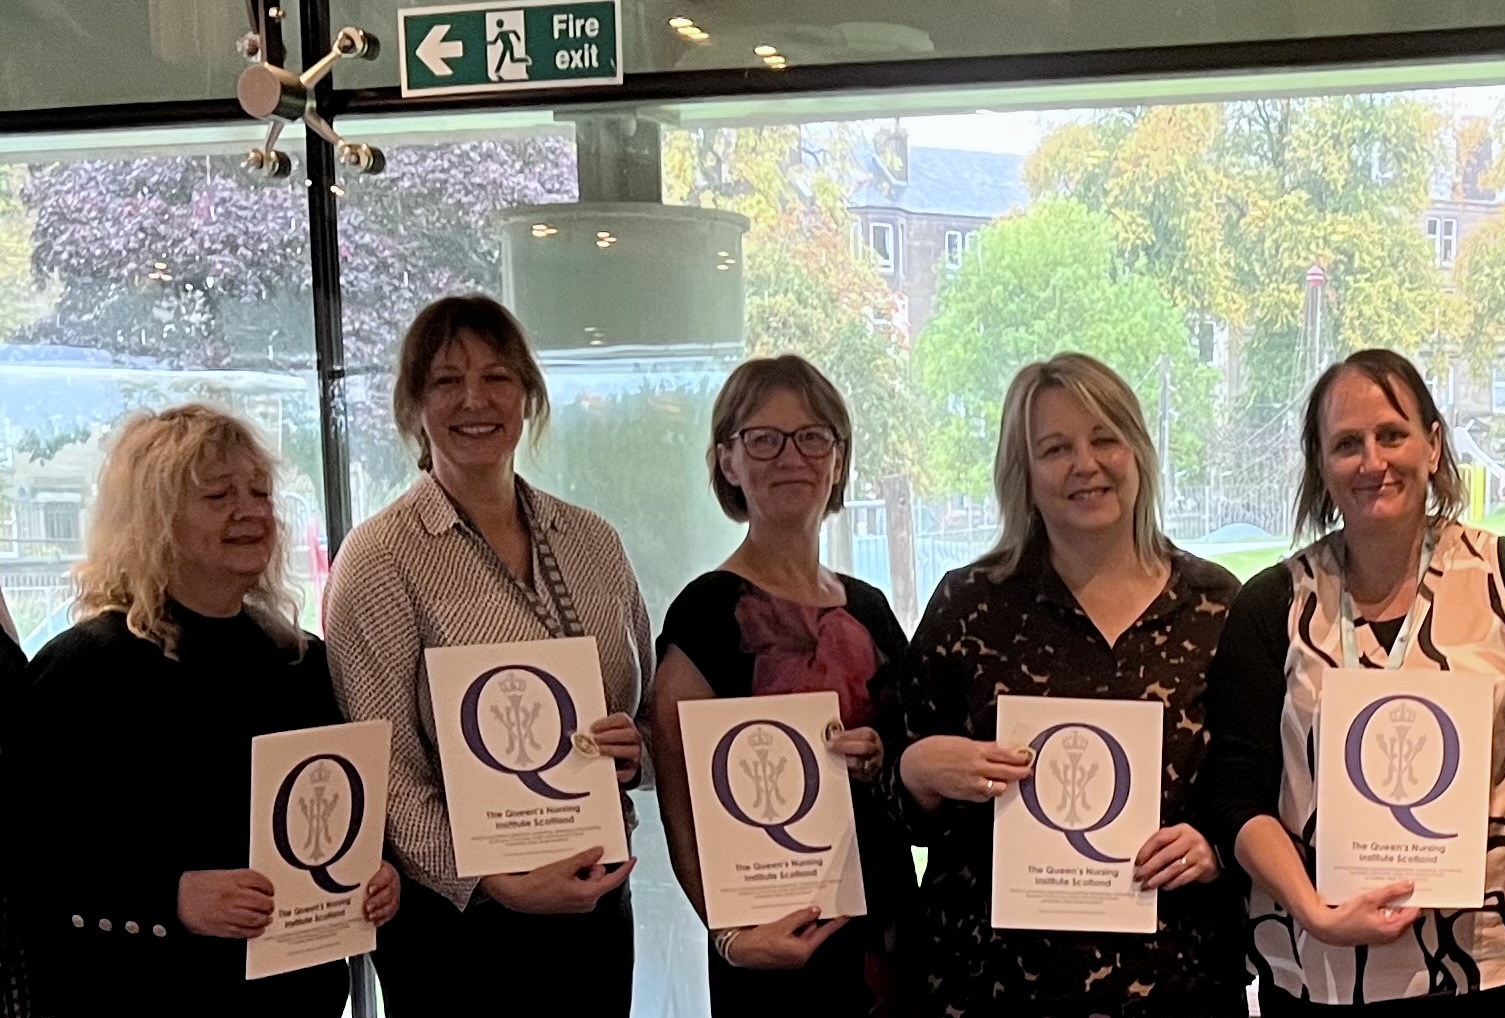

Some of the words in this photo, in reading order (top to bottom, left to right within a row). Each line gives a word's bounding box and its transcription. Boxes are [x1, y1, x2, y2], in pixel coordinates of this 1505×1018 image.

[552, 13, 599, 39] Fire
[555, 43, 599, 69] exit
[460, 665, 590, 800] Q
[1344, 695, 1460, 839] Q
[712, 719, 831, 854] Q
[1019, 723, 1131, 863] Q
[273, 754, 365, 893] Q
[1352, 841, 1367, 850] The
[1370, 842, 1409, 852] Queen's
[1412, 844, 1445, 854] Nursing
[1359, 854, 1393, 863] Institute
[1397, 855, 1437, 864] Scotland
[1028, 865, 1043, 874] The
[1086, 868, 1119, 877] Nursing
[1035, 877, 1069, 885] Institute
[1072, 878, 1111, 887] Scotland
